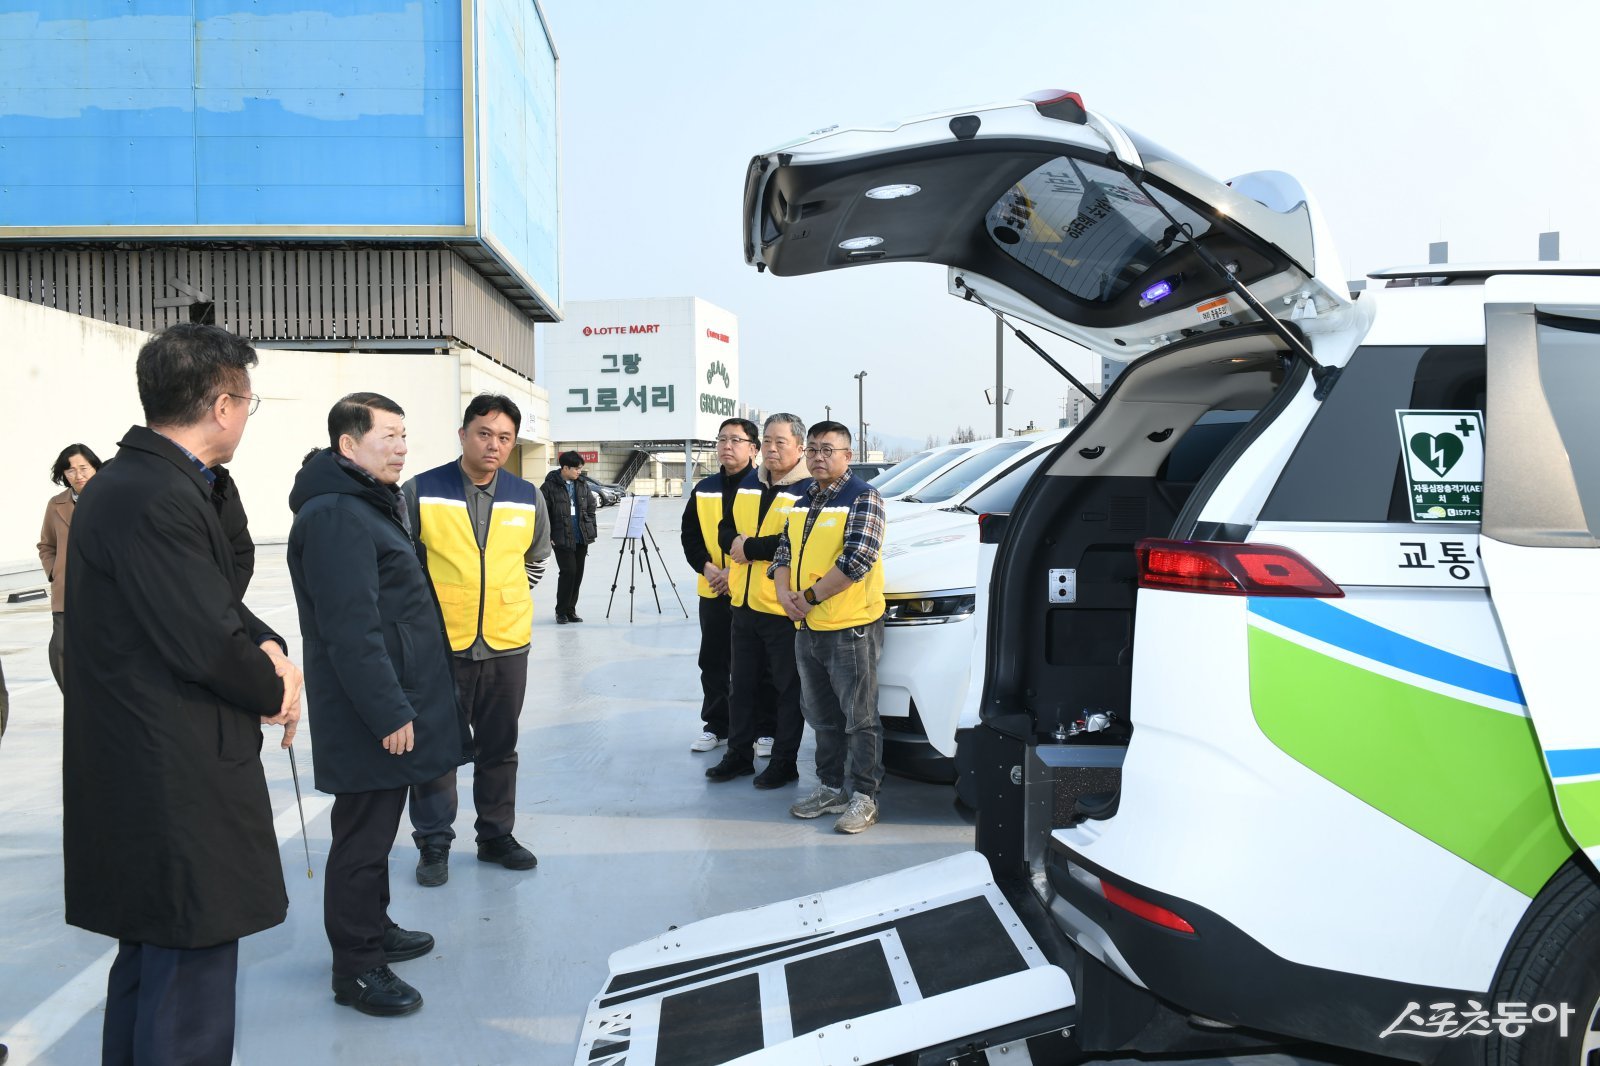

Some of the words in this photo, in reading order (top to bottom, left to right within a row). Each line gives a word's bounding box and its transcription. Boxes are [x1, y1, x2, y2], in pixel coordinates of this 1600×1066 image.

[594, 326, 627, 335] LOTTE
[629, 324, 660, 334] MART
[600, 353, 642, 375] 그랑
[566, 384, 675, 414] 그로서리
[699, 392, 737, 418] GROCERY
[1398, 541, 1482, 581] 교통
